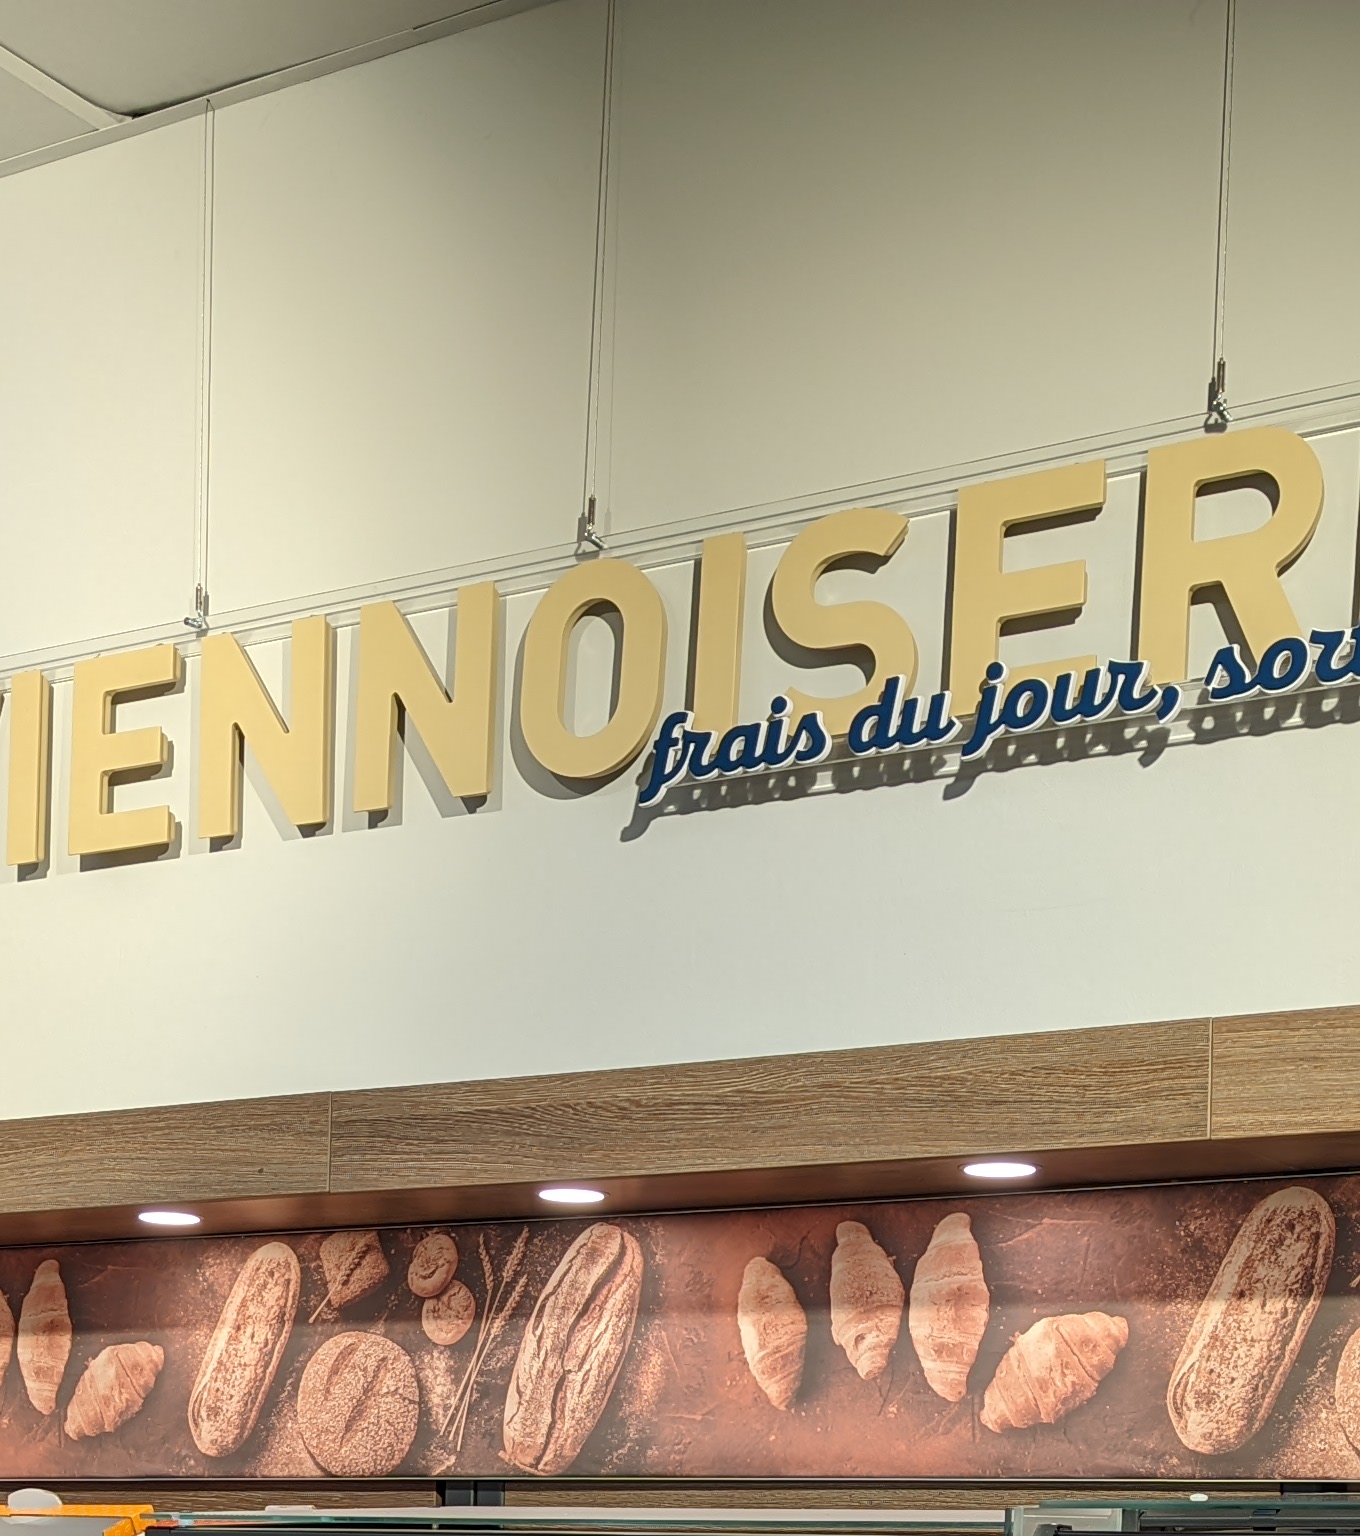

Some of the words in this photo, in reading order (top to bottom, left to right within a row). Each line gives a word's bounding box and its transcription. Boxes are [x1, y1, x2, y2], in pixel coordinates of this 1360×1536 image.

[639, 710, 833, 806] frais
[848, 673, 963, 756] du
[962, 658, 1181, 763] jour,
